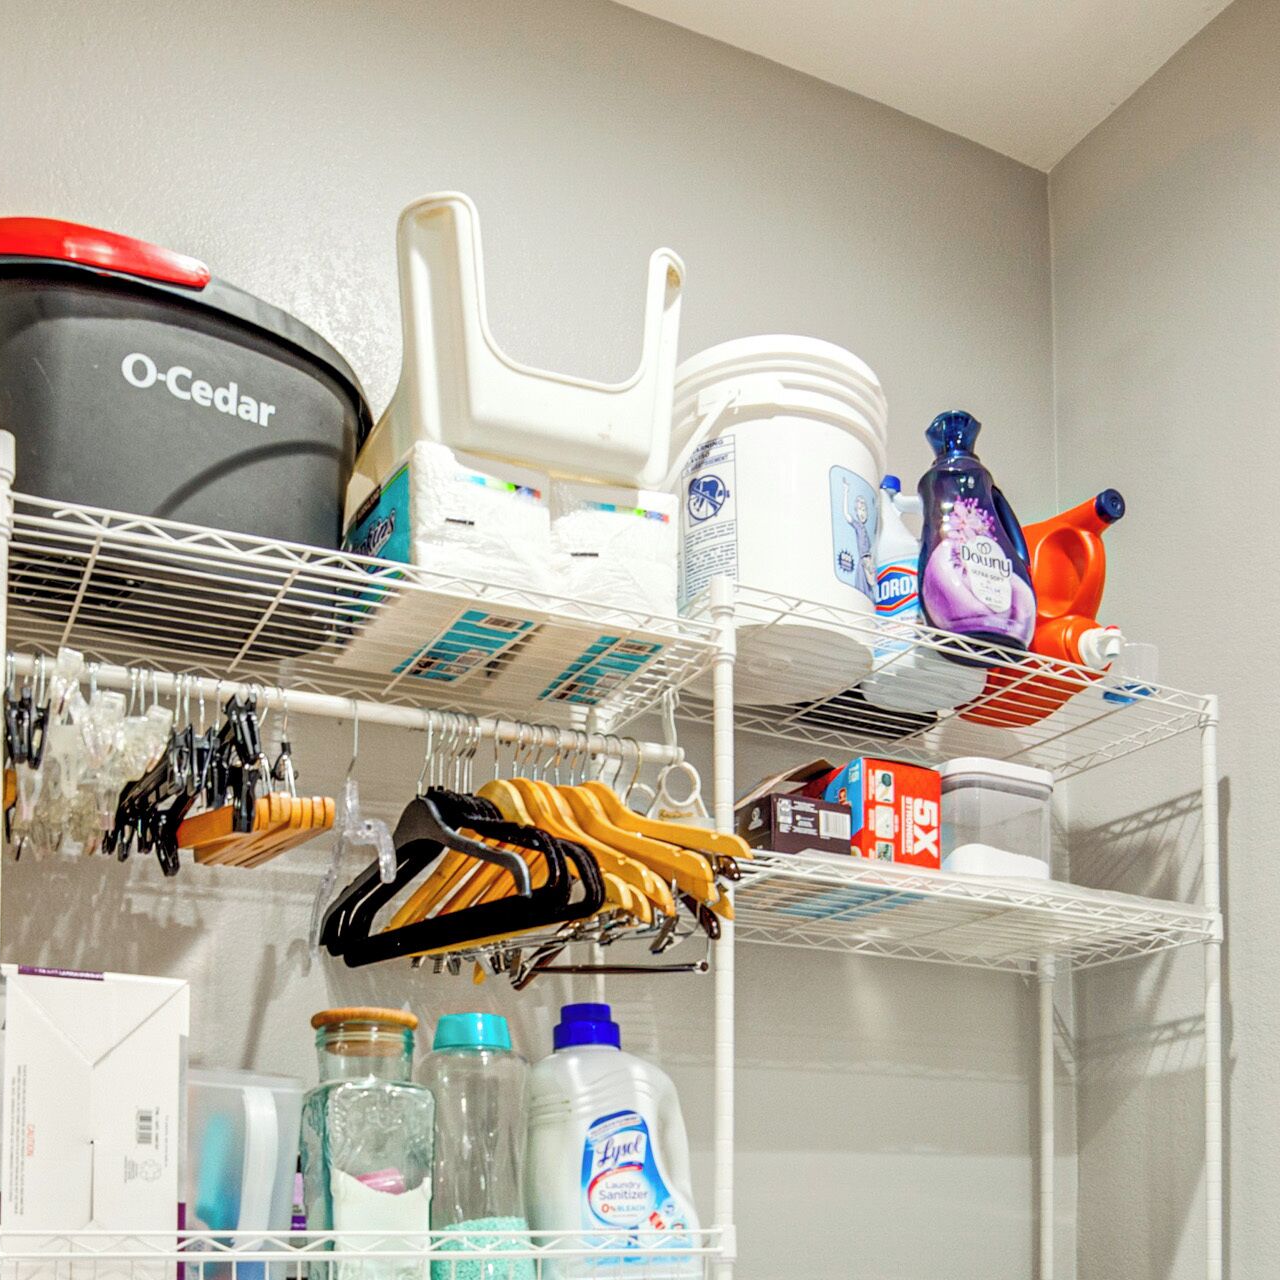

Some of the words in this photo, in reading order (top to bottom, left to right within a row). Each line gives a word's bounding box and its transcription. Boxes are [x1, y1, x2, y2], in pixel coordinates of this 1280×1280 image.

[121, 352, 276, 427] O-Cedar
[961, 545, 1011, 578] Downy
[876, 575, 919, 604] LOROX
[913, 798, 939, 859] 5X
[598, 1134, 642, 1165] Lysol
[599, 1189, 649, 1200] Sanitizer
[605, 1181, 640, 1191] Laundry
